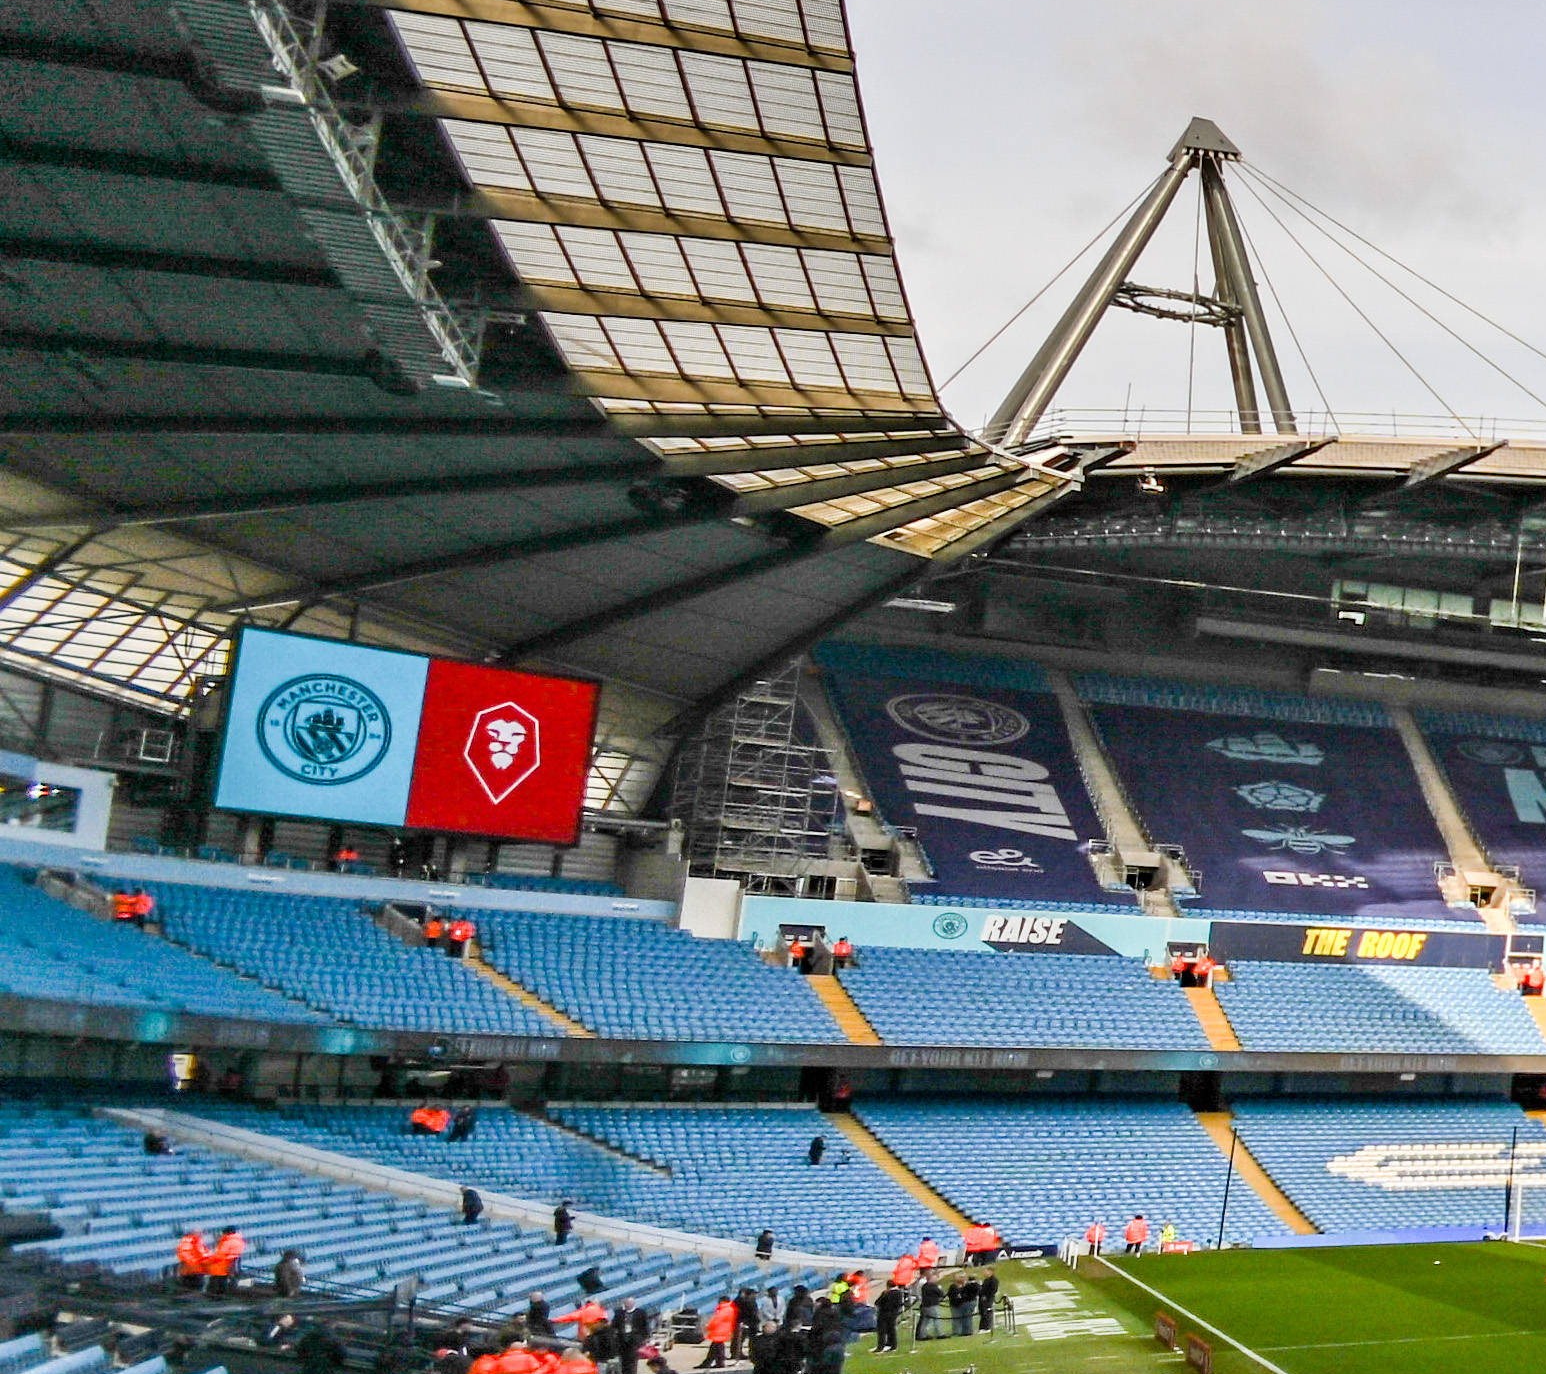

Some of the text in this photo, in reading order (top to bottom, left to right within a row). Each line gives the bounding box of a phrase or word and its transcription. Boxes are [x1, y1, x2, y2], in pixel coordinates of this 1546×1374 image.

[277, 682, 379, 722] MANCHESTER
[301, 764, 338, 777] CITY
[892, 743, 1078, 841] CITY
[979, 915, 1068, 945] RAISE
[1302, 927, 1428, 961] THE ROOF
